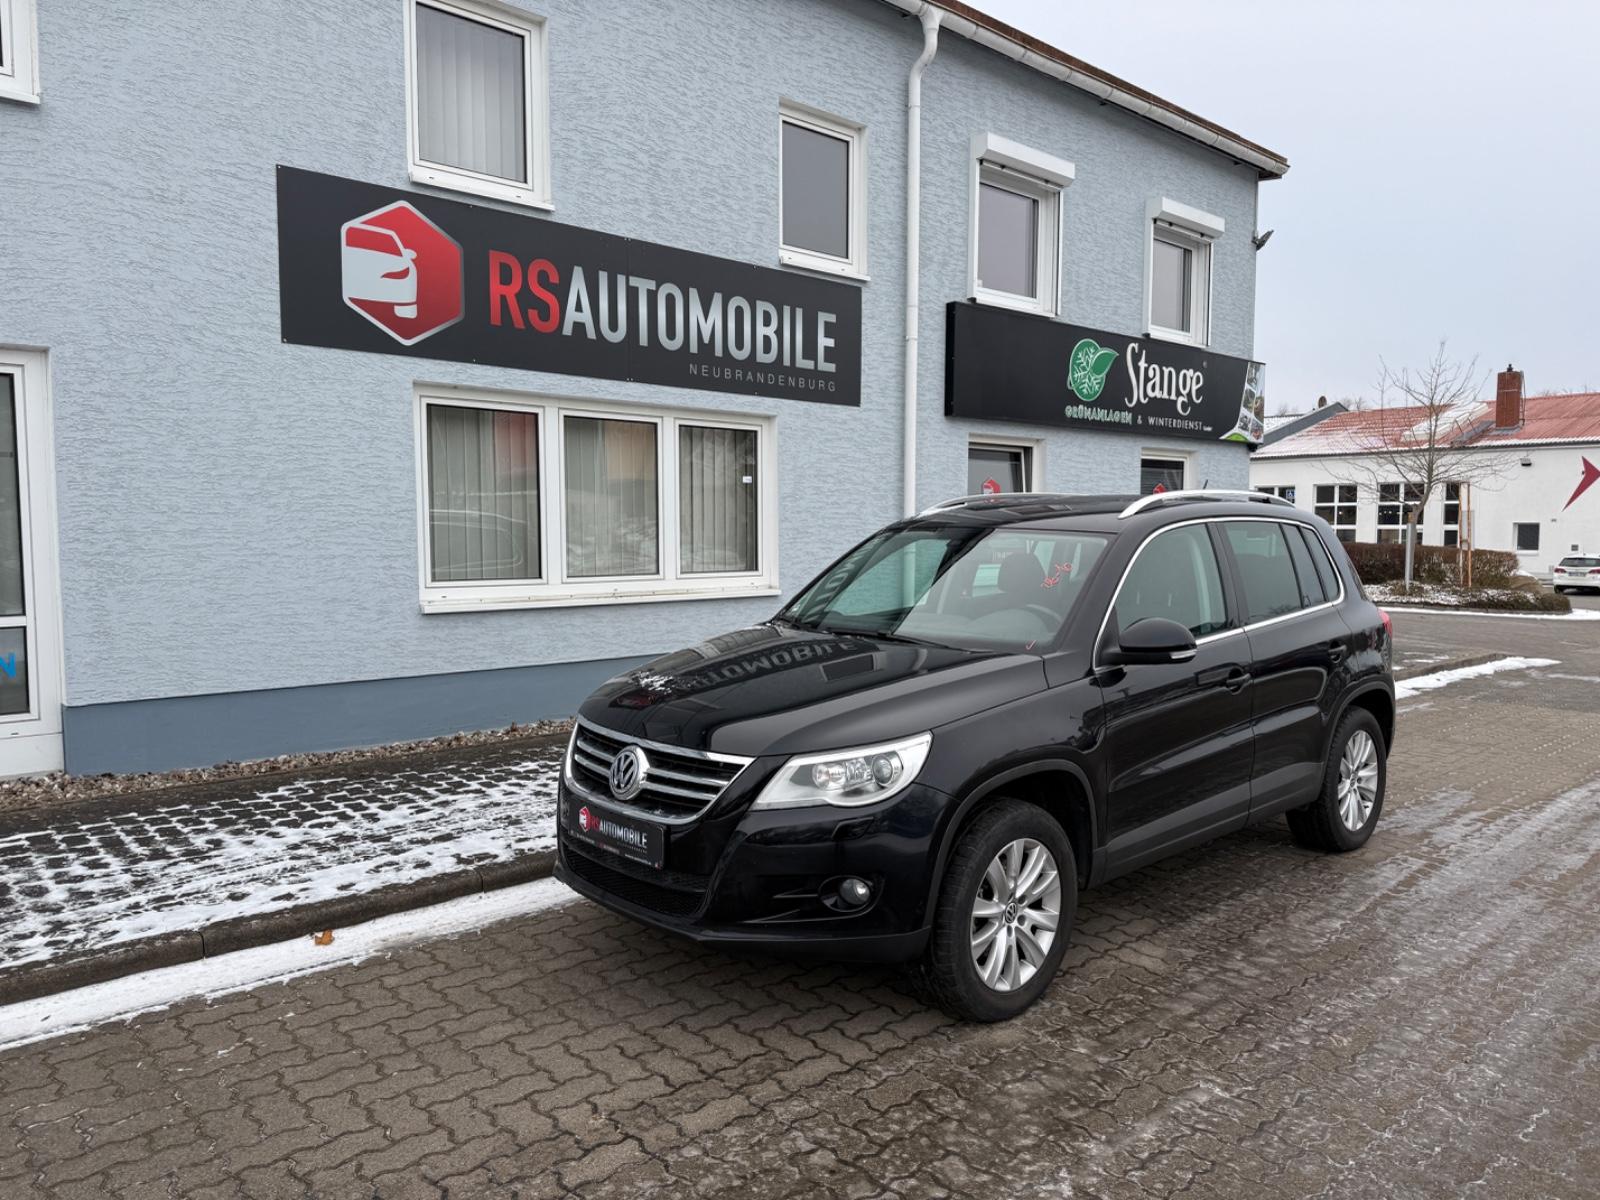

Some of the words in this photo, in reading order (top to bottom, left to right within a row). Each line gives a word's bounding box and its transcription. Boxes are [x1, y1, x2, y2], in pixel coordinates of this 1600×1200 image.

[689, 363, 836, 392] NEUBRANDENBURG
[1125, 342, 1203, 416] Stange
[1064, 404, 1132, 425] GRÜNANLAGEN
[1147, 415, 1202, 430] WINTERDIENST
